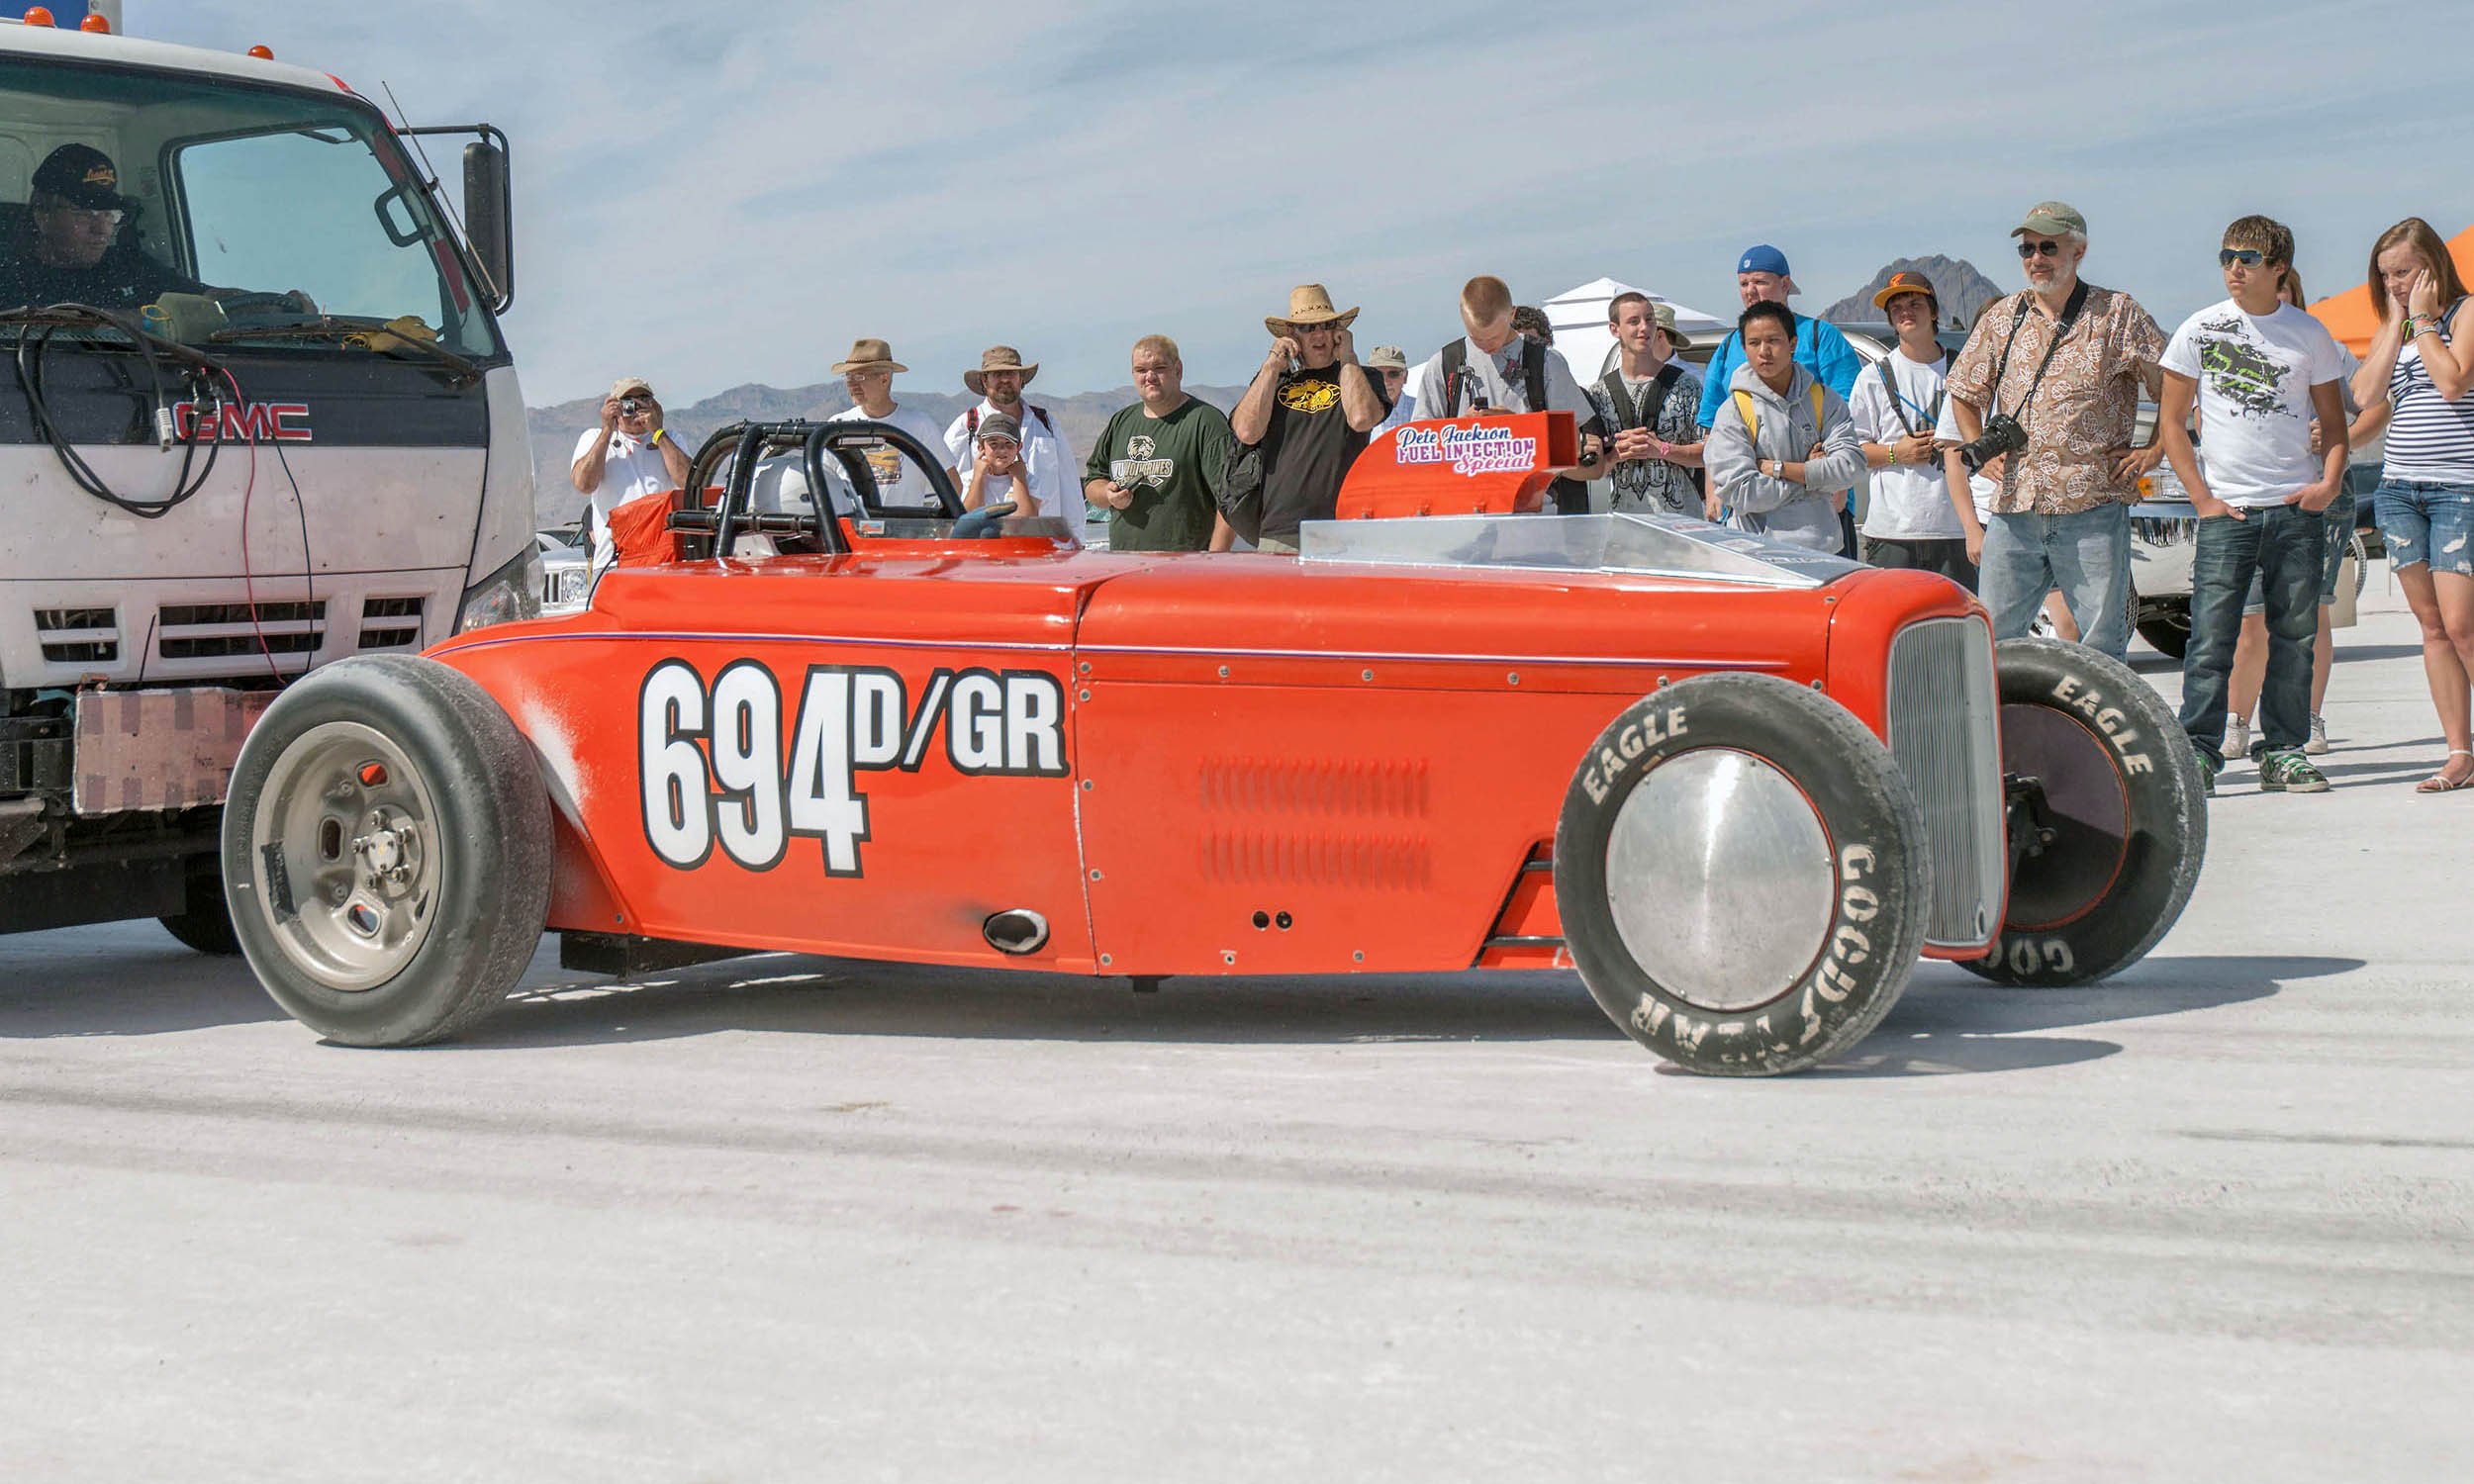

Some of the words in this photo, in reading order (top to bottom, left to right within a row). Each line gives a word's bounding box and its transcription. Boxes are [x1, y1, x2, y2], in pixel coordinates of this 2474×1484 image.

[173, 402, 313, 441] GMC
[1397, 426, 1439, 448] Pete
[1441, 424, 1511, 445] Jackson
[1396, 444, 1442, 463] FUEL
[1455, 450, 1535, 475] Special
[2051, 675, 2153, 775] EAGLE
[641, 659, 868, 877] 694
[852, 667, 1068, 777] D/GR
[1583, 705, 1688, 805] EAGLE
